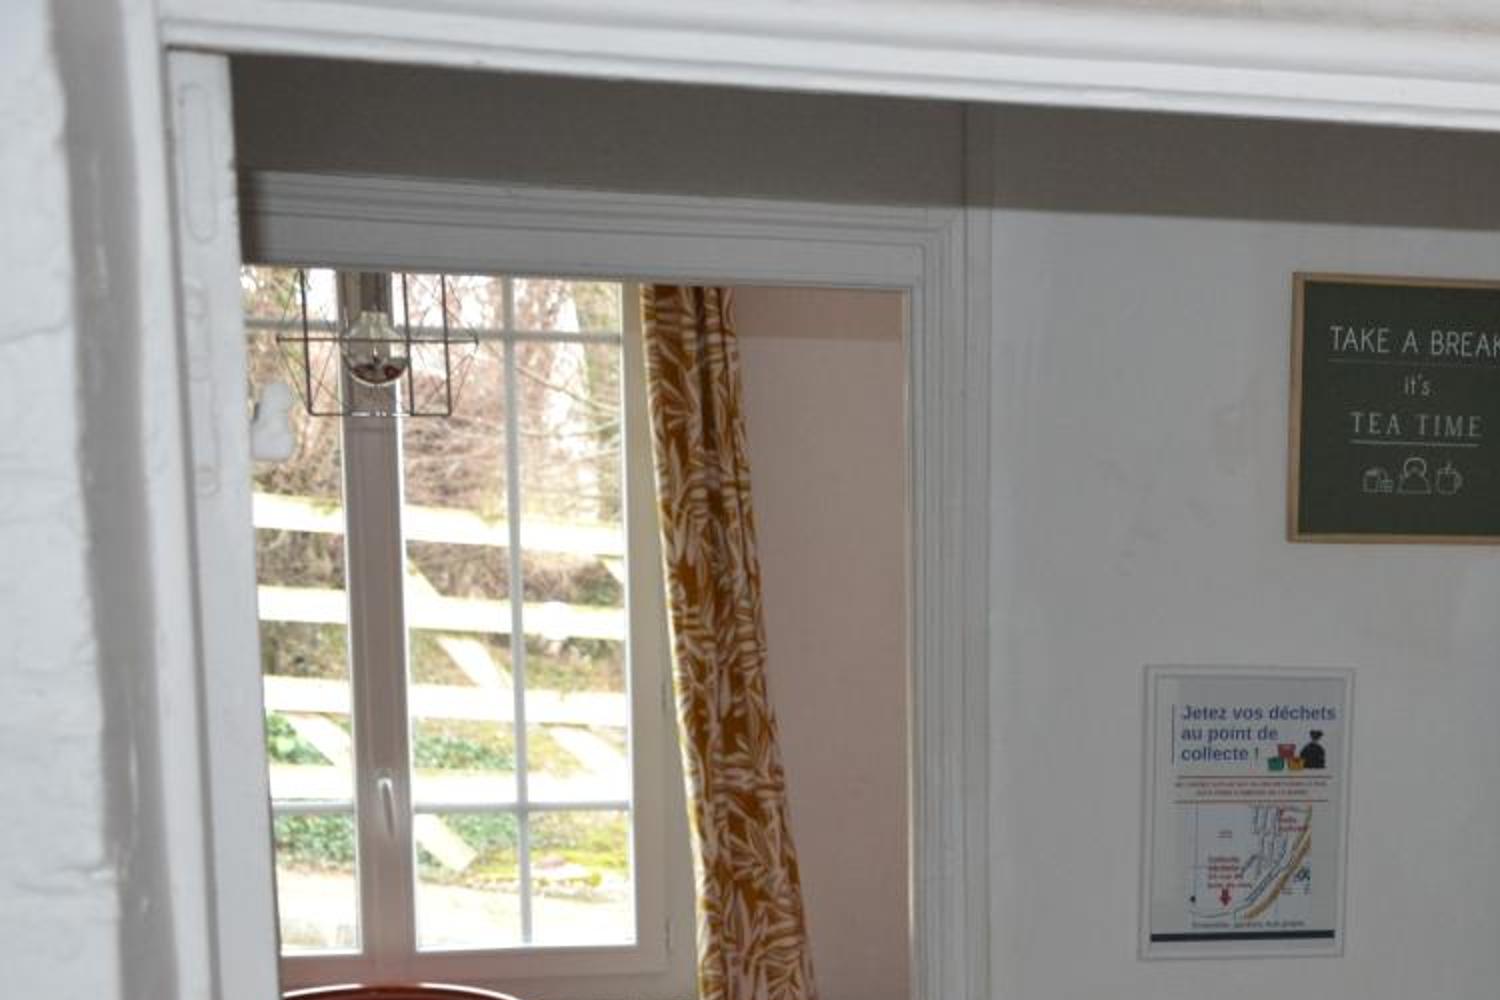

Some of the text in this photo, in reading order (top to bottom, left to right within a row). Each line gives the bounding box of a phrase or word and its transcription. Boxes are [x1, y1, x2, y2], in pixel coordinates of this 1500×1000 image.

[1330, 325, 1391, 353] TAKE
[1401, 329, 1420, 353] A
[1404, 373, 1431, 396] it's
[1350, 411, 1483, 438] TEA TIME
[1182, 704, 1336, 721] Jetez vos déchets
[1180, 725, 1279, 746] au point de
[1180, 745, 1249, 763] collecte
